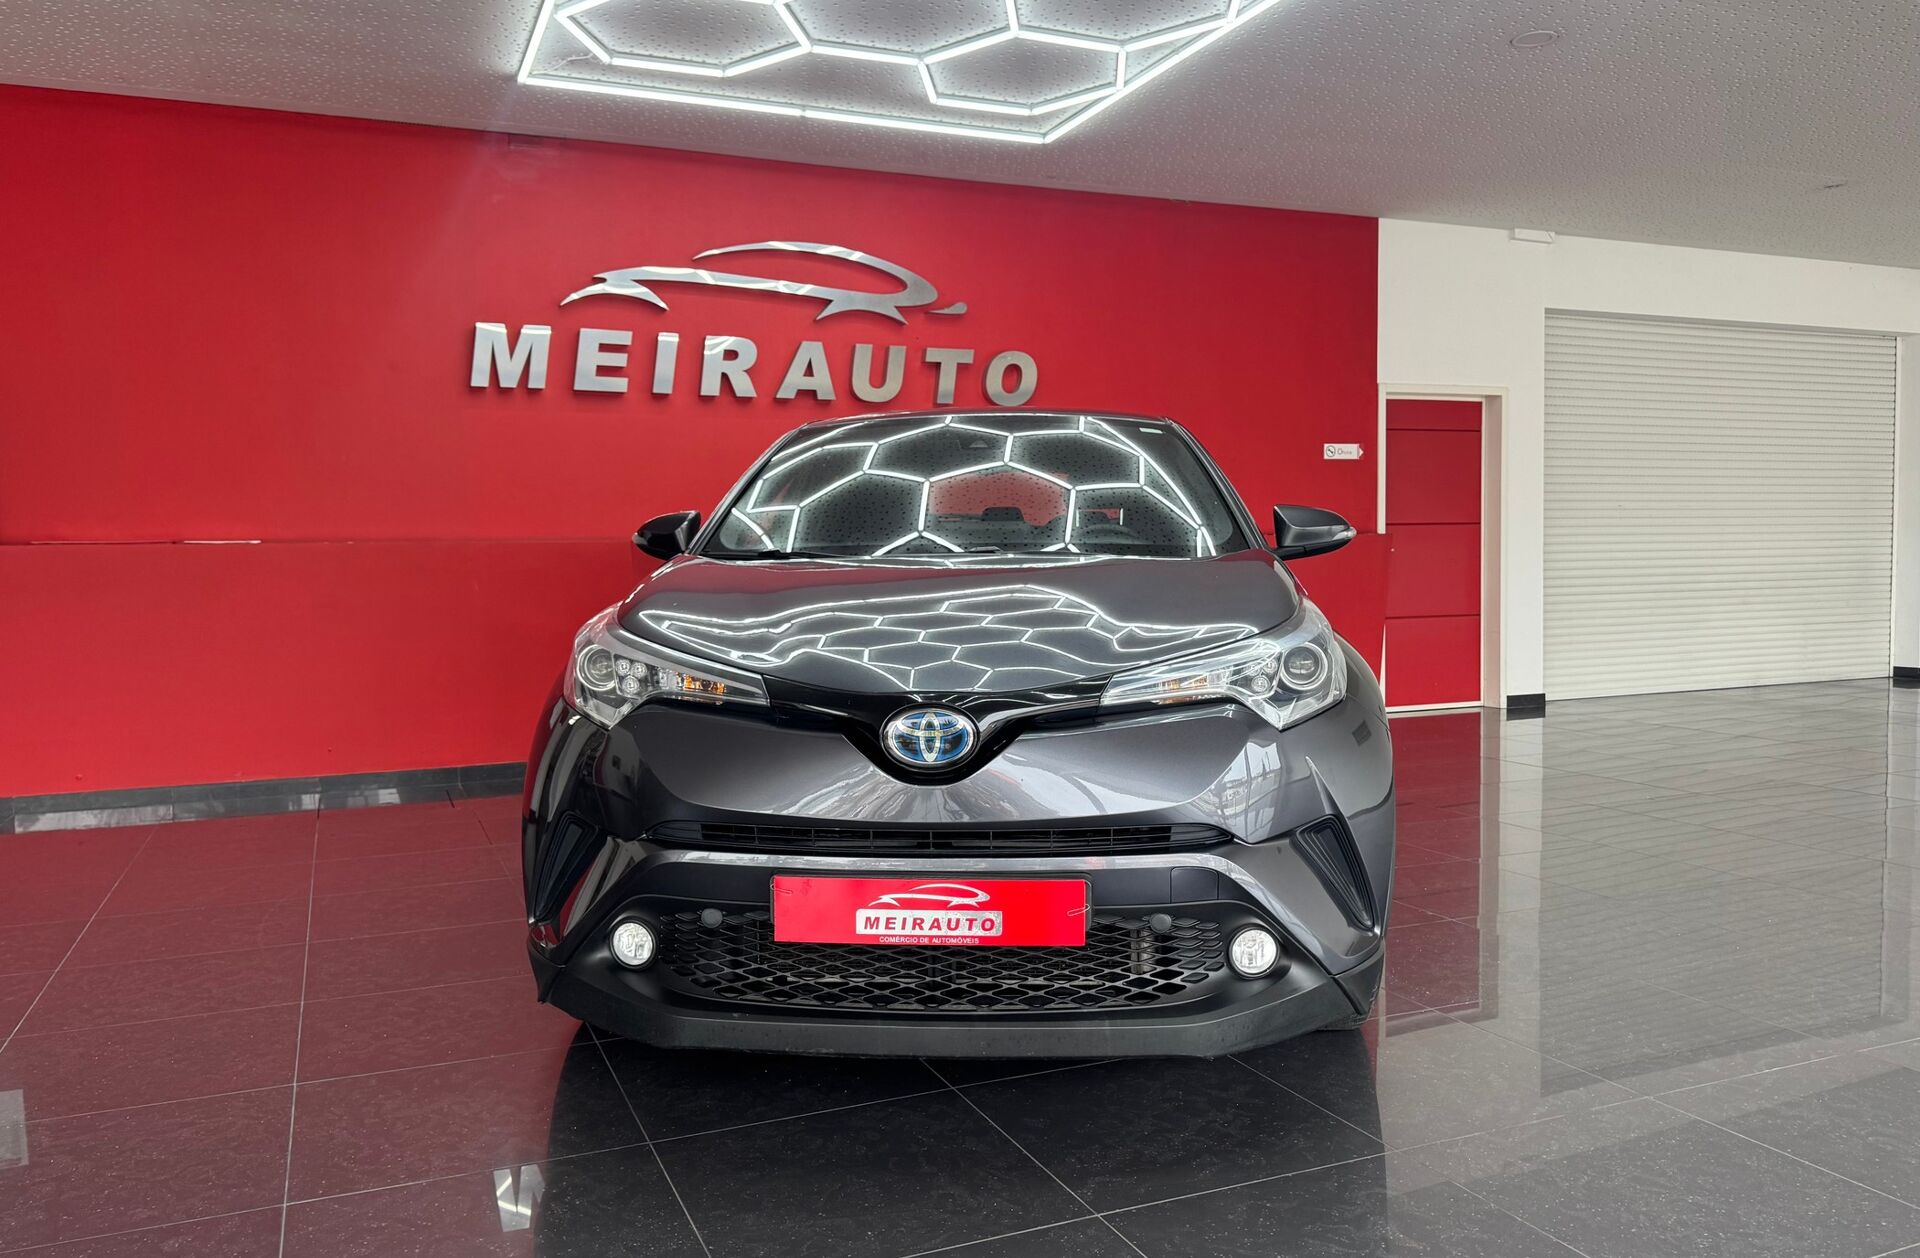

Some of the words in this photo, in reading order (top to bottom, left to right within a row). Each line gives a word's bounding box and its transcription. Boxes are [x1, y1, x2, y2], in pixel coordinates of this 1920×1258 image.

[469, 321, 1039, 407] MEIRAUTO
[863, 916, 996, 932] MEIRAUTO
[879, 935, 918, 944] COMÉRCIO
[920, 936, 930, 944] DE
[932, 936, 980, 945] AUTOMÓVEIS
